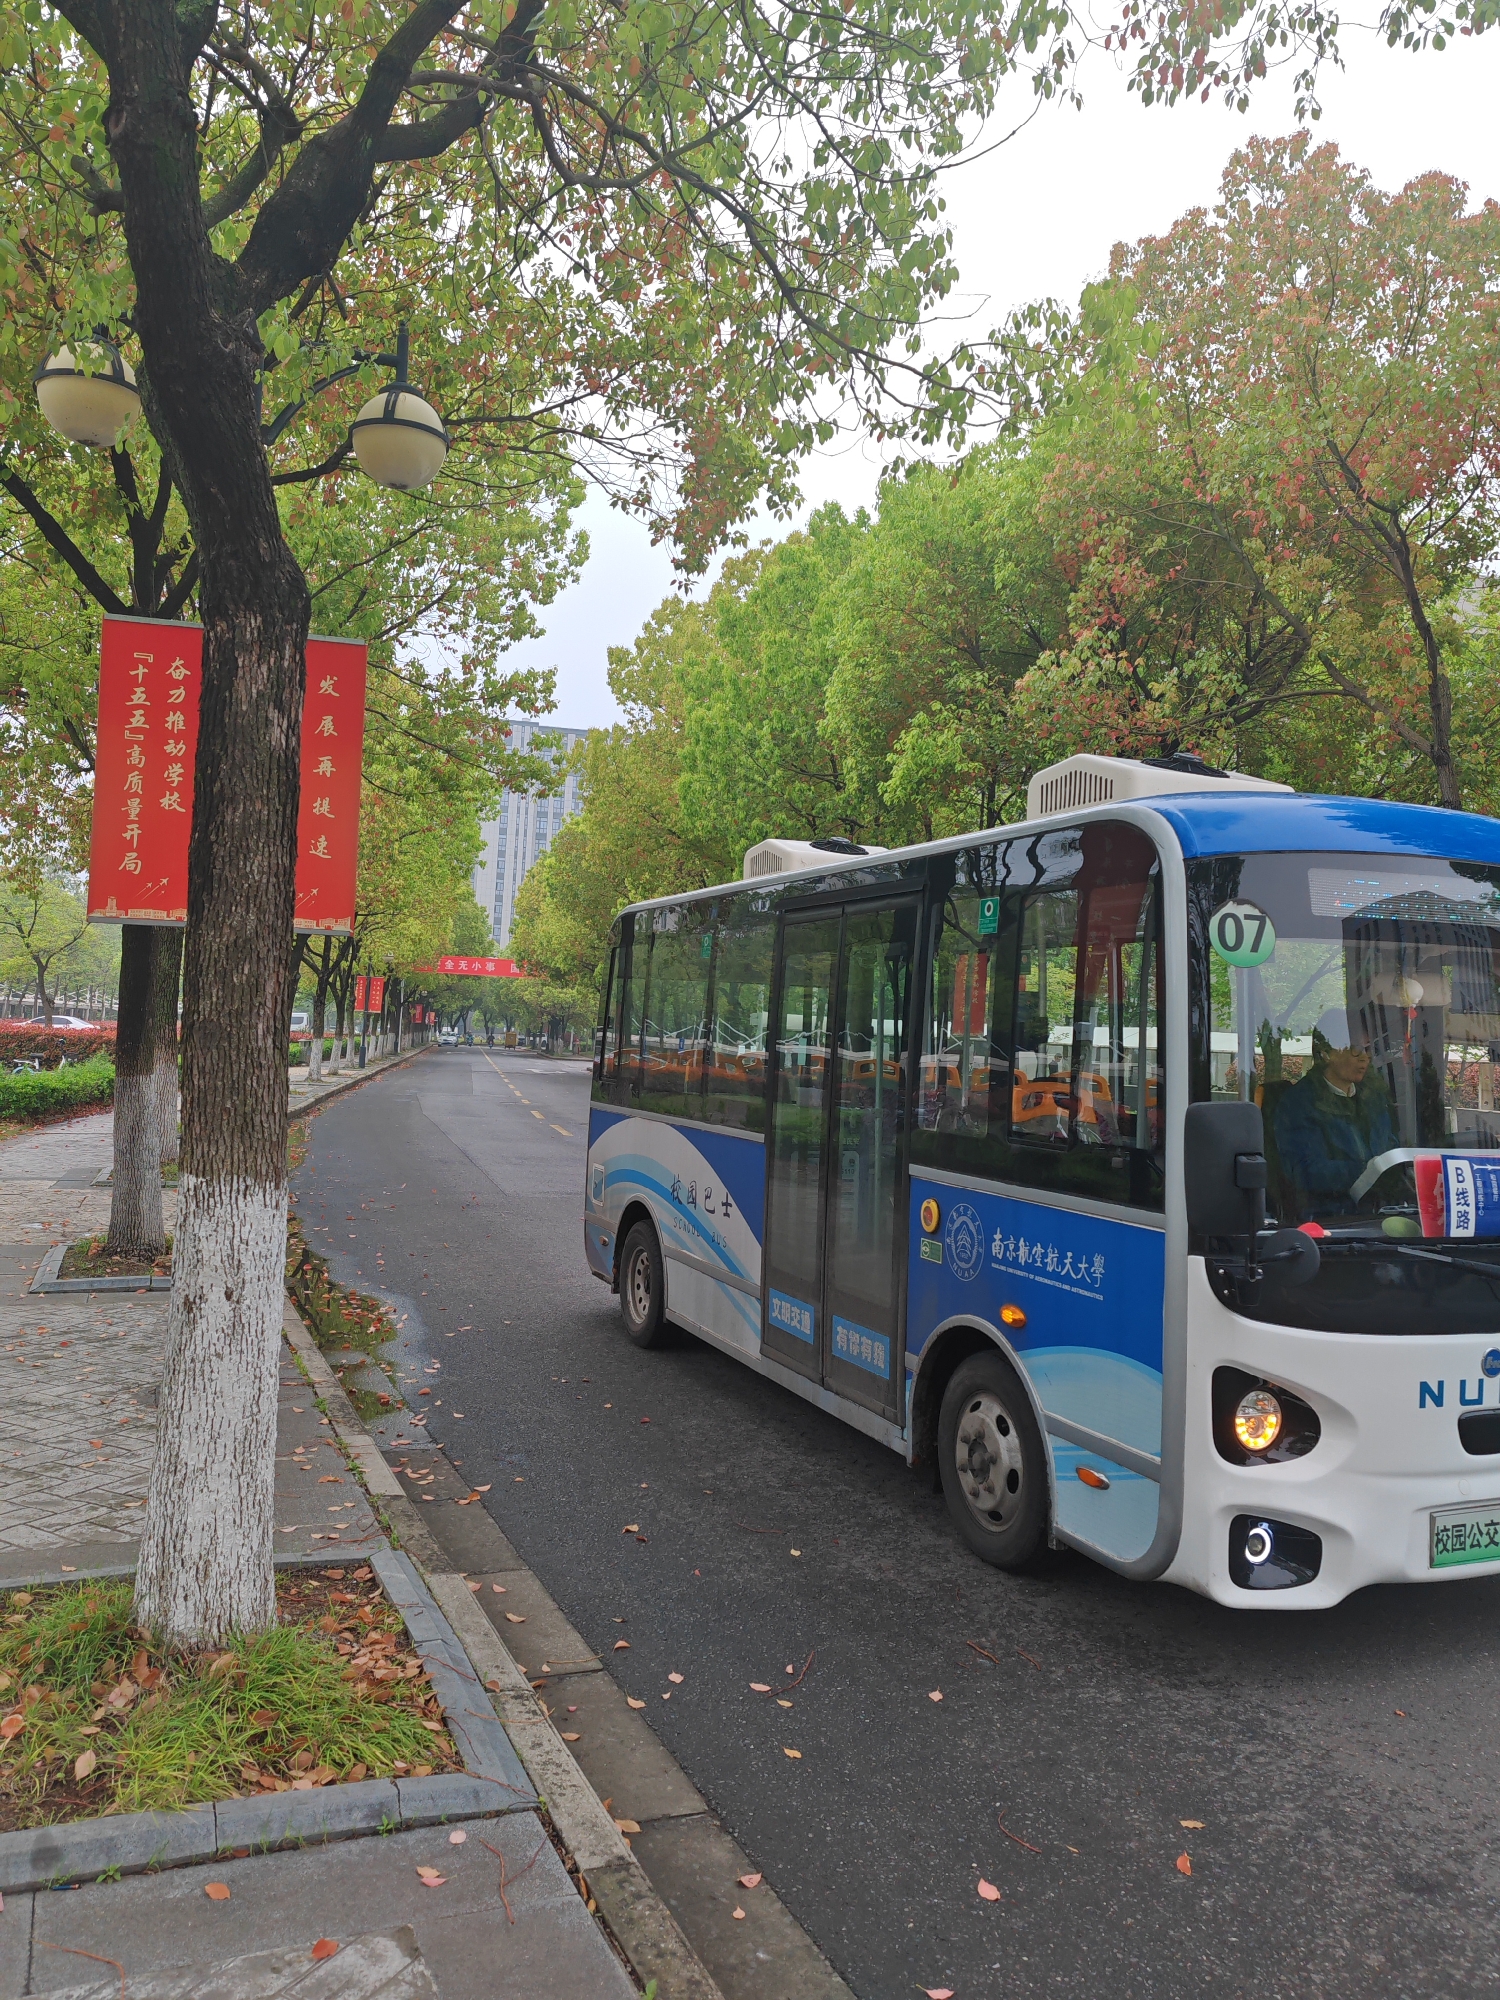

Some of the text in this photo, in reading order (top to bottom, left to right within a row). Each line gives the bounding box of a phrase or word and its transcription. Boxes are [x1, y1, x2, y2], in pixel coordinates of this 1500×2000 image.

[159, 656, 192, 813] 奋力推动学校
[118, 652, 154, 875] 『十五五』高质量开局
[309, 675, 341, 859] 发展再提速
[1217, 912, 1267, 953] 07
[670, 1173, 733, 1219] 校园巴士
[1454, 1167, 1470, 1231] B线路
[673, 1216, 727, 1248] SCHOOL BUS
[953, 1262, 975, 1278] NUAA
[1062, 1283, 1071, 1291] AND
[771, 1297, 811, 1335] 文明交通
[1418, 1378, 1500, 1409] NU
[1434, 1519, 1500, 1556] 校园公交
